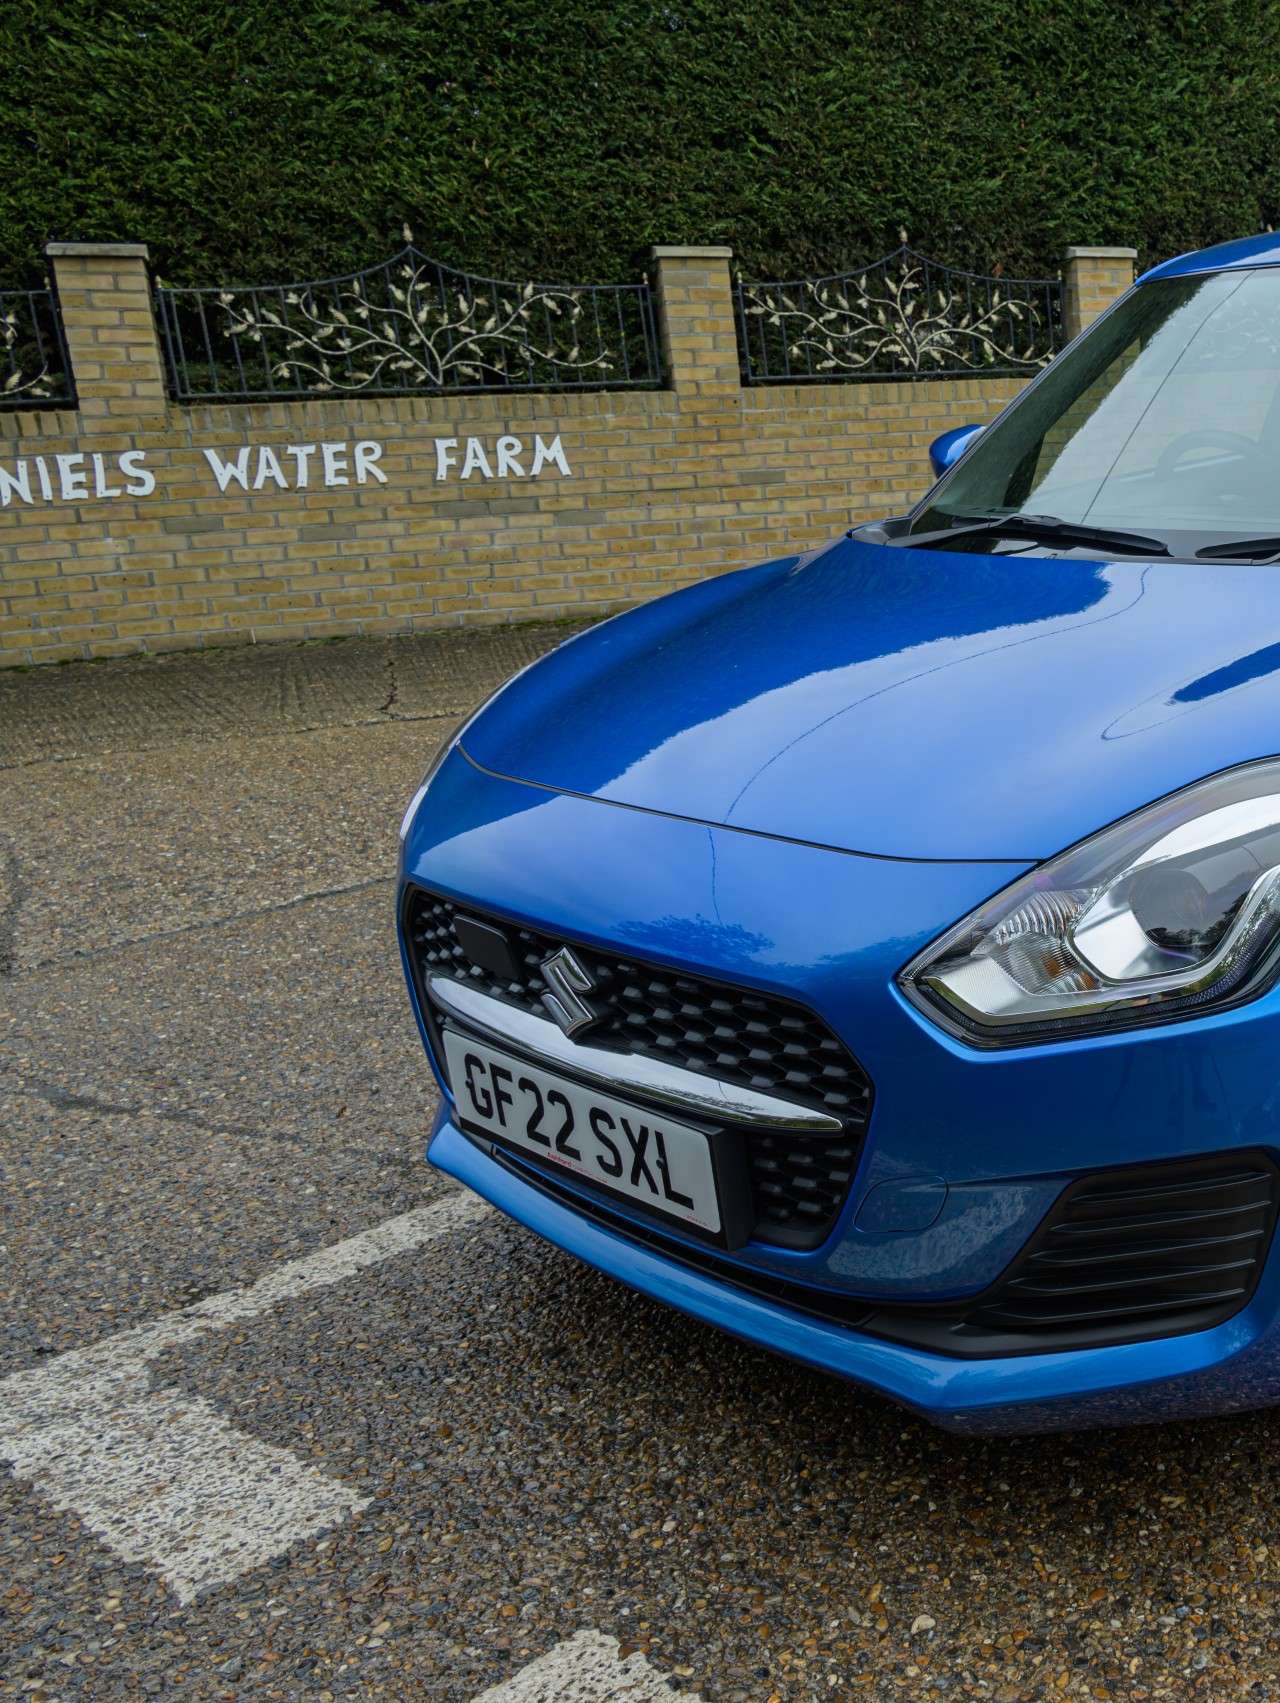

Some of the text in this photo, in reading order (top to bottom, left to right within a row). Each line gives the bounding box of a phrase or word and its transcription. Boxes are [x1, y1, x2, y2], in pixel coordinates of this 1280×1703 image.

[0, 434, 573, 506] NIELS WATER FARM
[464, 1053, 694, 1211] GF22 SXL
